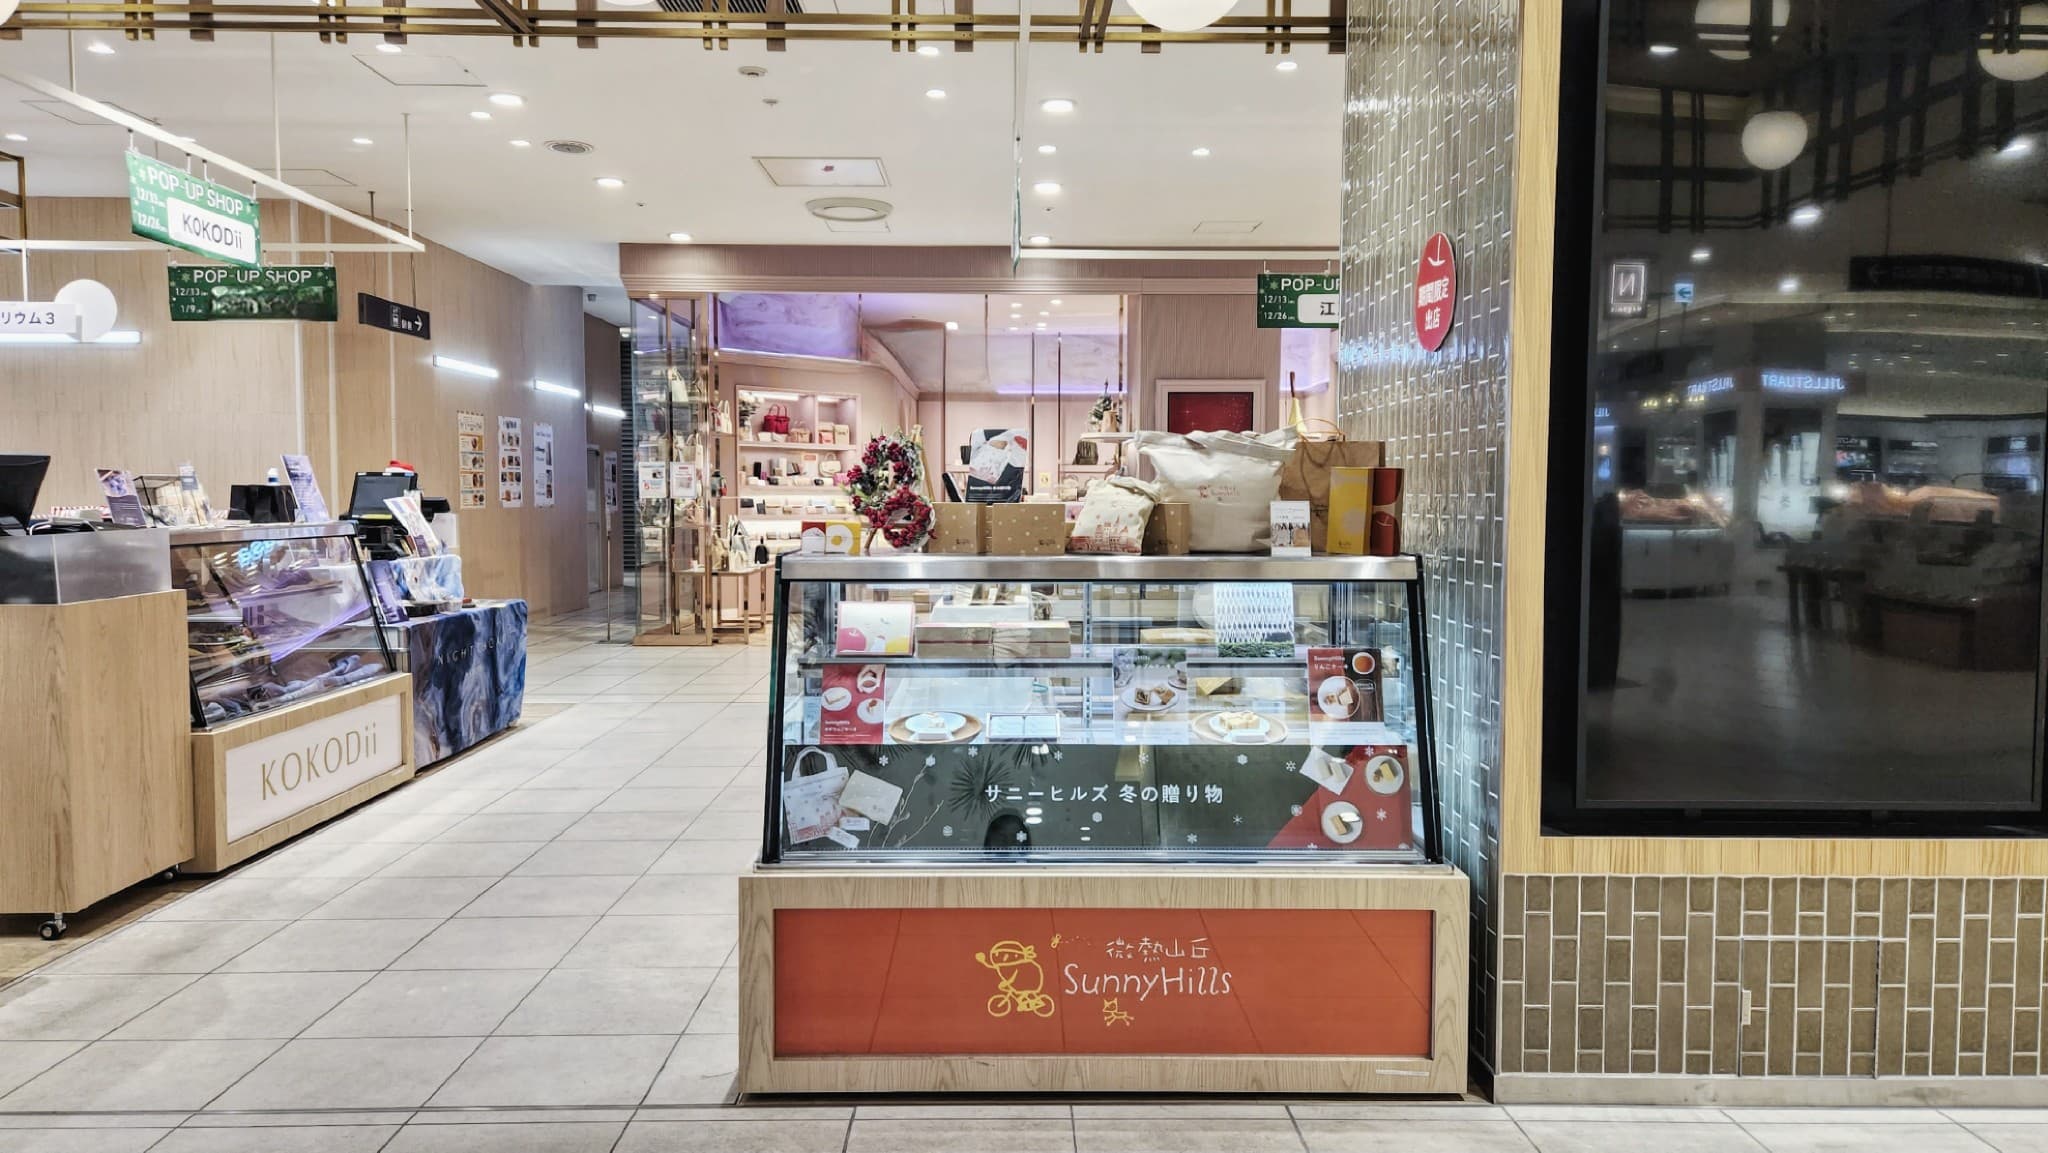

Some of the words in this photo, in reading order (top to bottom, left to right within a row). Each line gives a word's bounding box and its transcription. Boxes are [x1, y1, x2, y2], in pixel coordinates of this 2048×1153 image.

[147, 166, 204, 200] POP-UP
[207, 189, 244, 216] SHOP
[182, 213, 242, 249] KOKODii
[193, 270, 260, 284] POP-UP
[265, 270, 312, 284] SHOP
[1264, 295, 1287, 304] 12/13
[1, 312, 55, 325] リウム3
[1264, 311, 1287, 320] 12/26
[261, 721, 377, 801] KOKODii
[984, 783, 1110, 803] サニーヒルズ
[1118, 783, 1224, 804] 冬の贈り物
[1105, 936, 1211, 962] 微熱山丘
[1063, 963, 1233, 1002] SunnyHills
